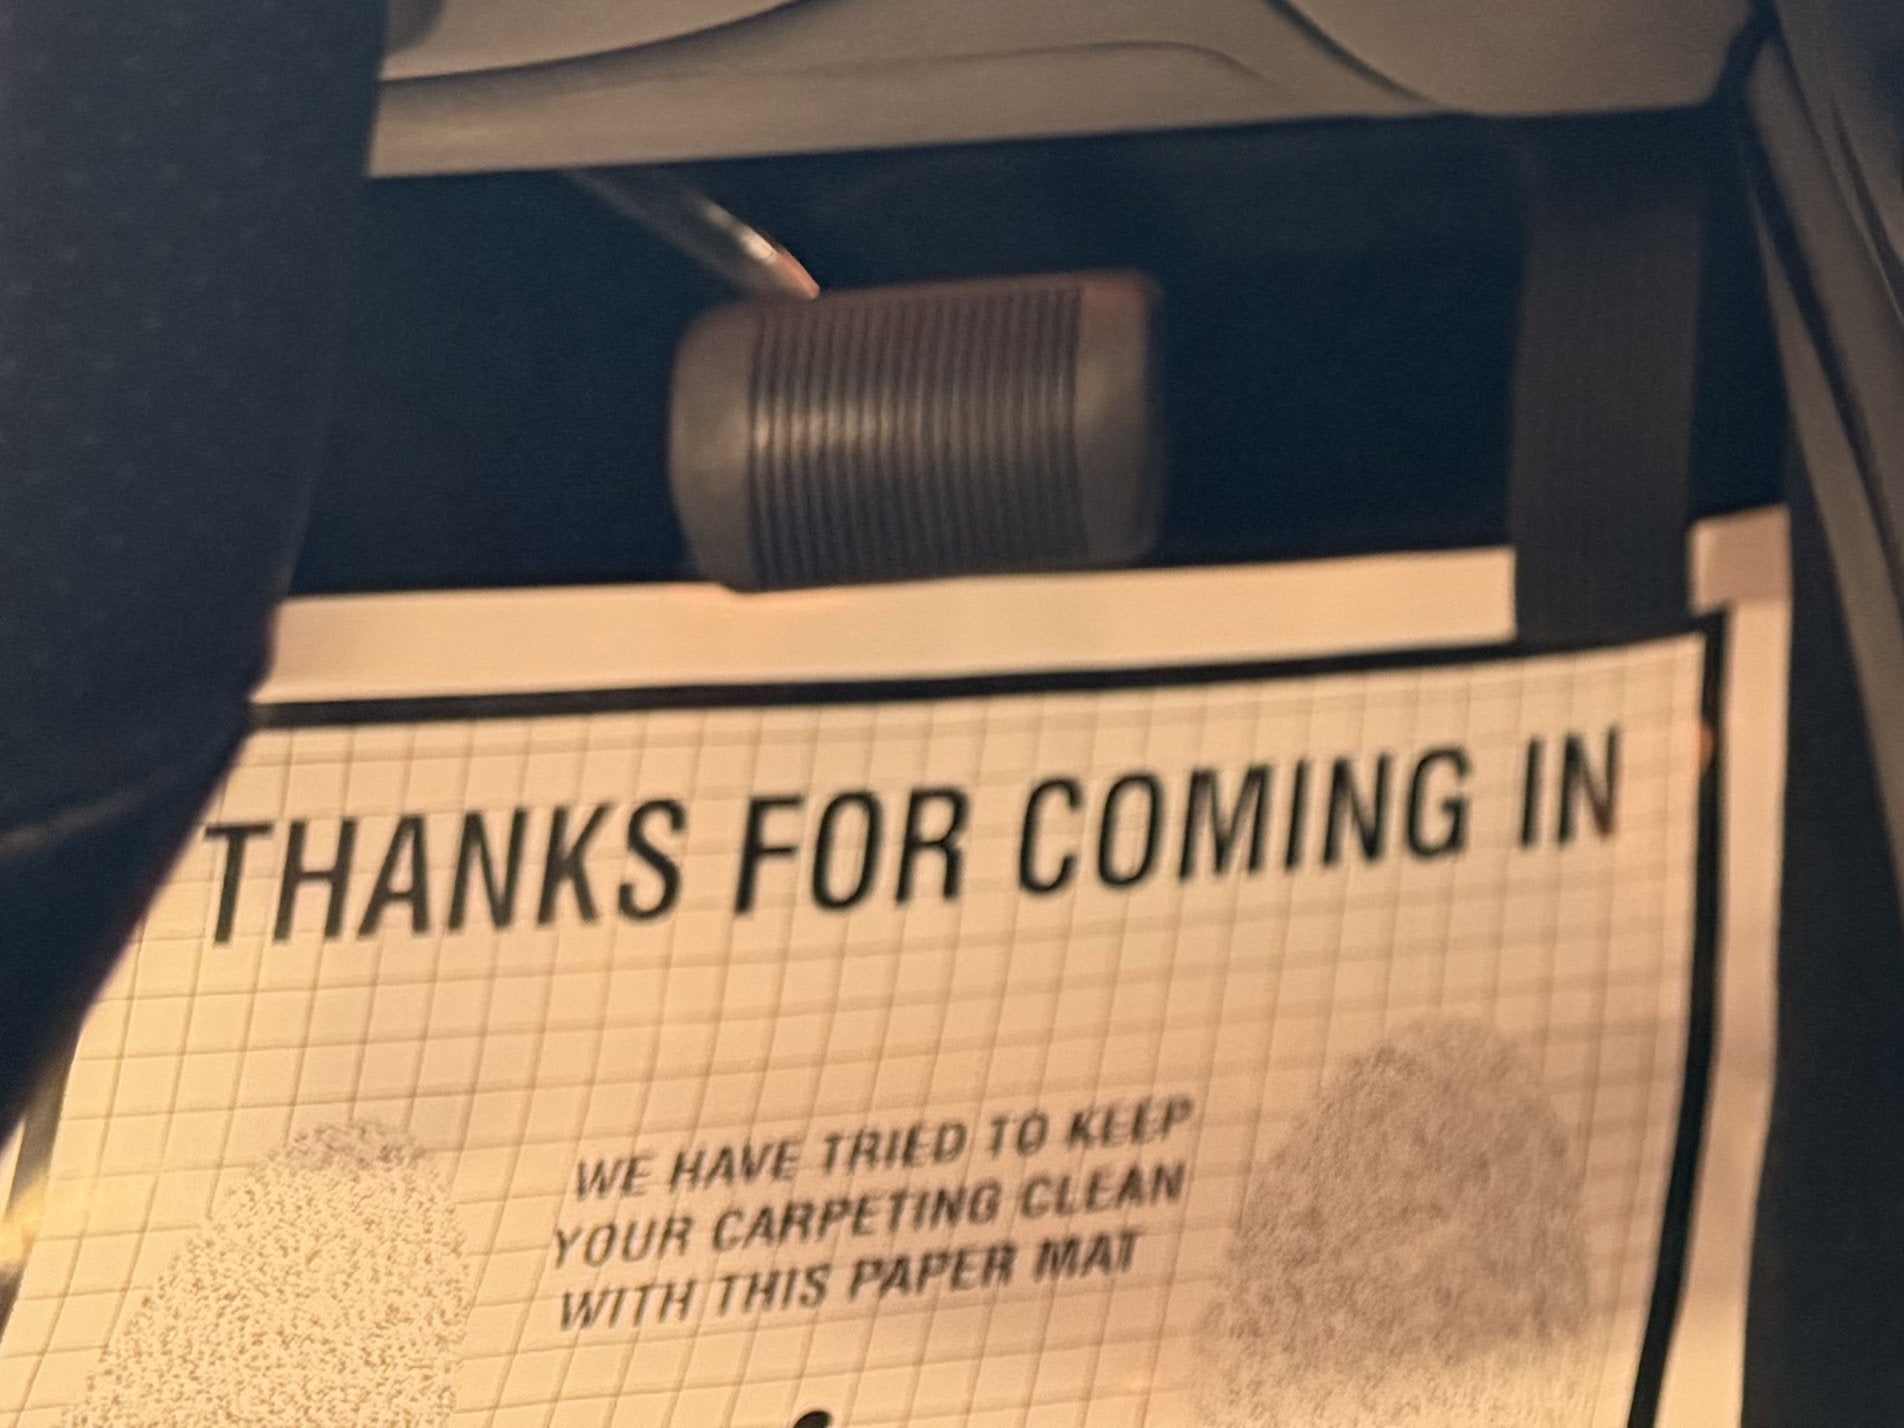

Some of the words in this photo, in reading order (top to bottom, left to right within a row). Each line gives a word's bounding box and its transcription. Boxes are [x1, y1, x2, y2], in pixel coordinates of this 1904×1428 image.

[204, 796, 688, 944] THANKS
[731, 787, 969, 916] FOR
[1016, 745, 1473, 895] COMING
[1519, 725, 1621, 848] IN
[575, 1156, 648, 1202] WE
[668, 1139, 800, 1194] HAVE
[824, 1120, 983, 1180] TRIED
[991, 1111, 1048, 1158] TO
[1069, 1095, 1193, 1146] KEEP
[553, 1216, 693, 1273] YOUR
[712, 1186, 998, 1265] CARPETING
[1020, 1161, 1186, 1218] CLEAN
[560, 1280, 697, 1332] WITH
[716, 1262, 825, 1317] THIS
[847, 1239, 1015, 1301] PAPER
[1034, 1227, 1146, 1281] MAT
